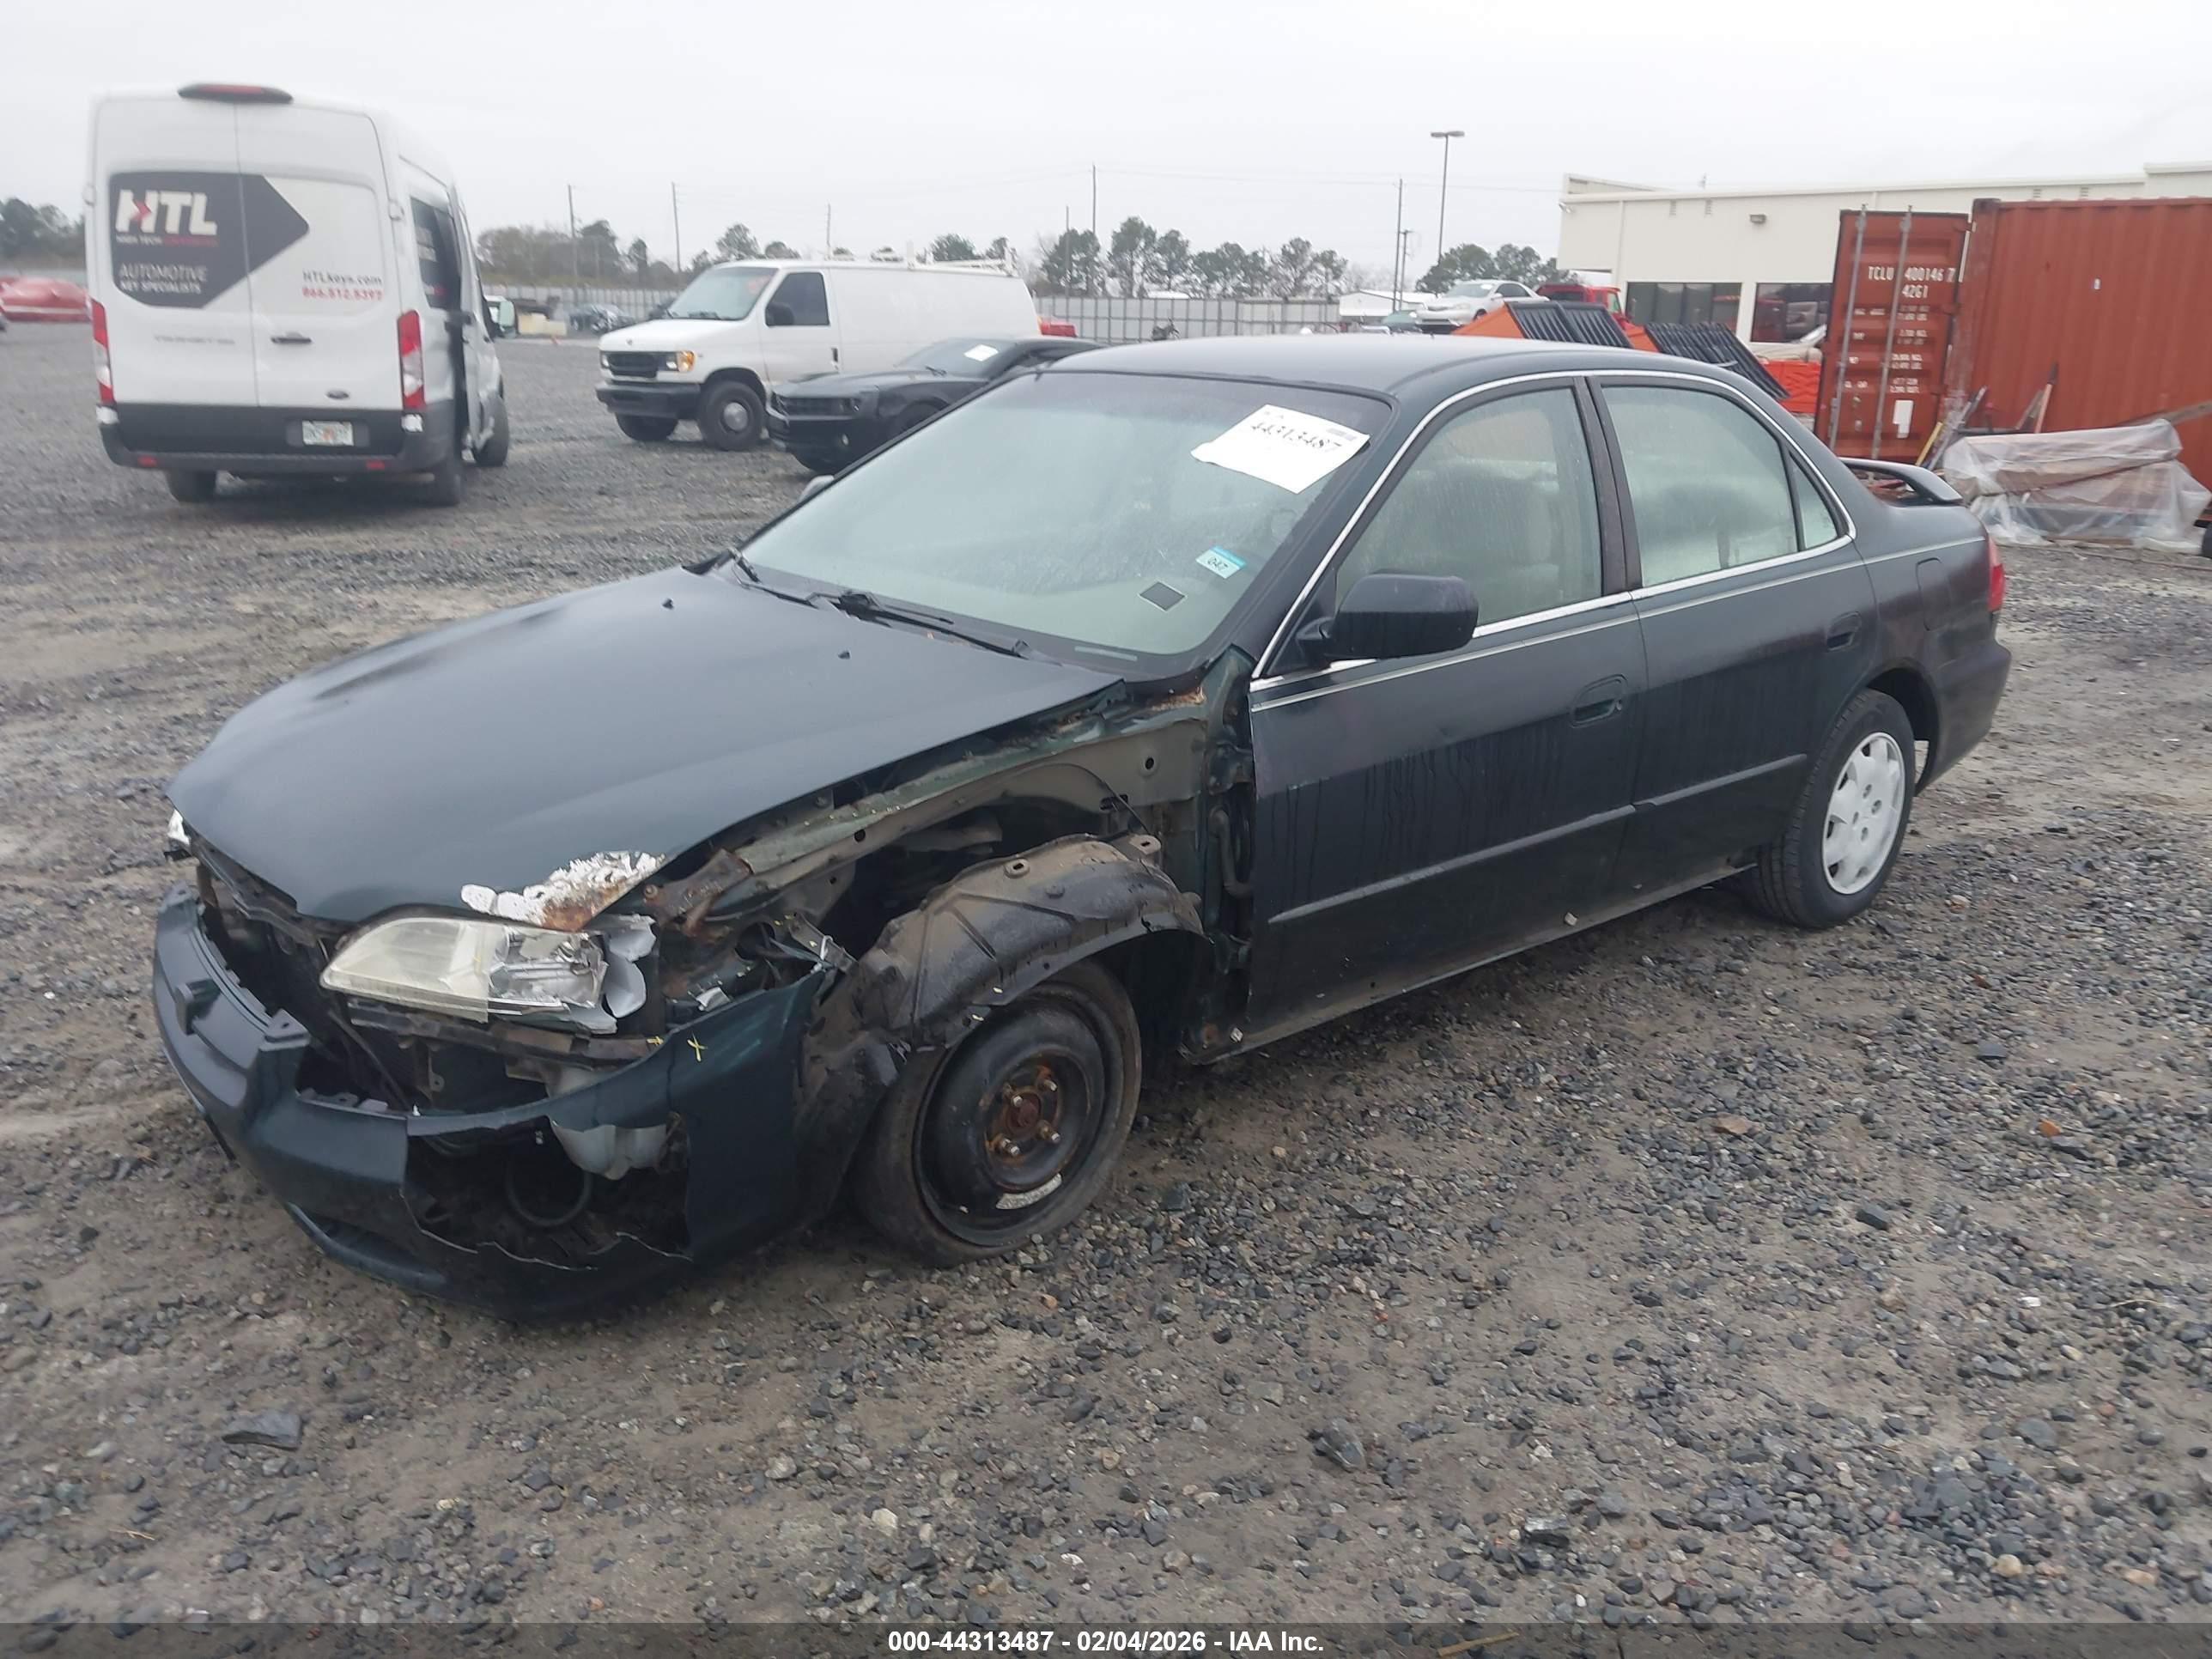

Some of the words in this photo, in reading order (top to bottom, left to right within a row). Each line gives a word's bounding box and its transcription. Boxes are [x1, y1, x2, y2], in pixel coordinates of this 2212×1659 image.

[115, 189, 218, 235] HTL
[120, 262, 208, 283] AUTOMOTIVE
[1868, 265, 1895, 281] TCLU
